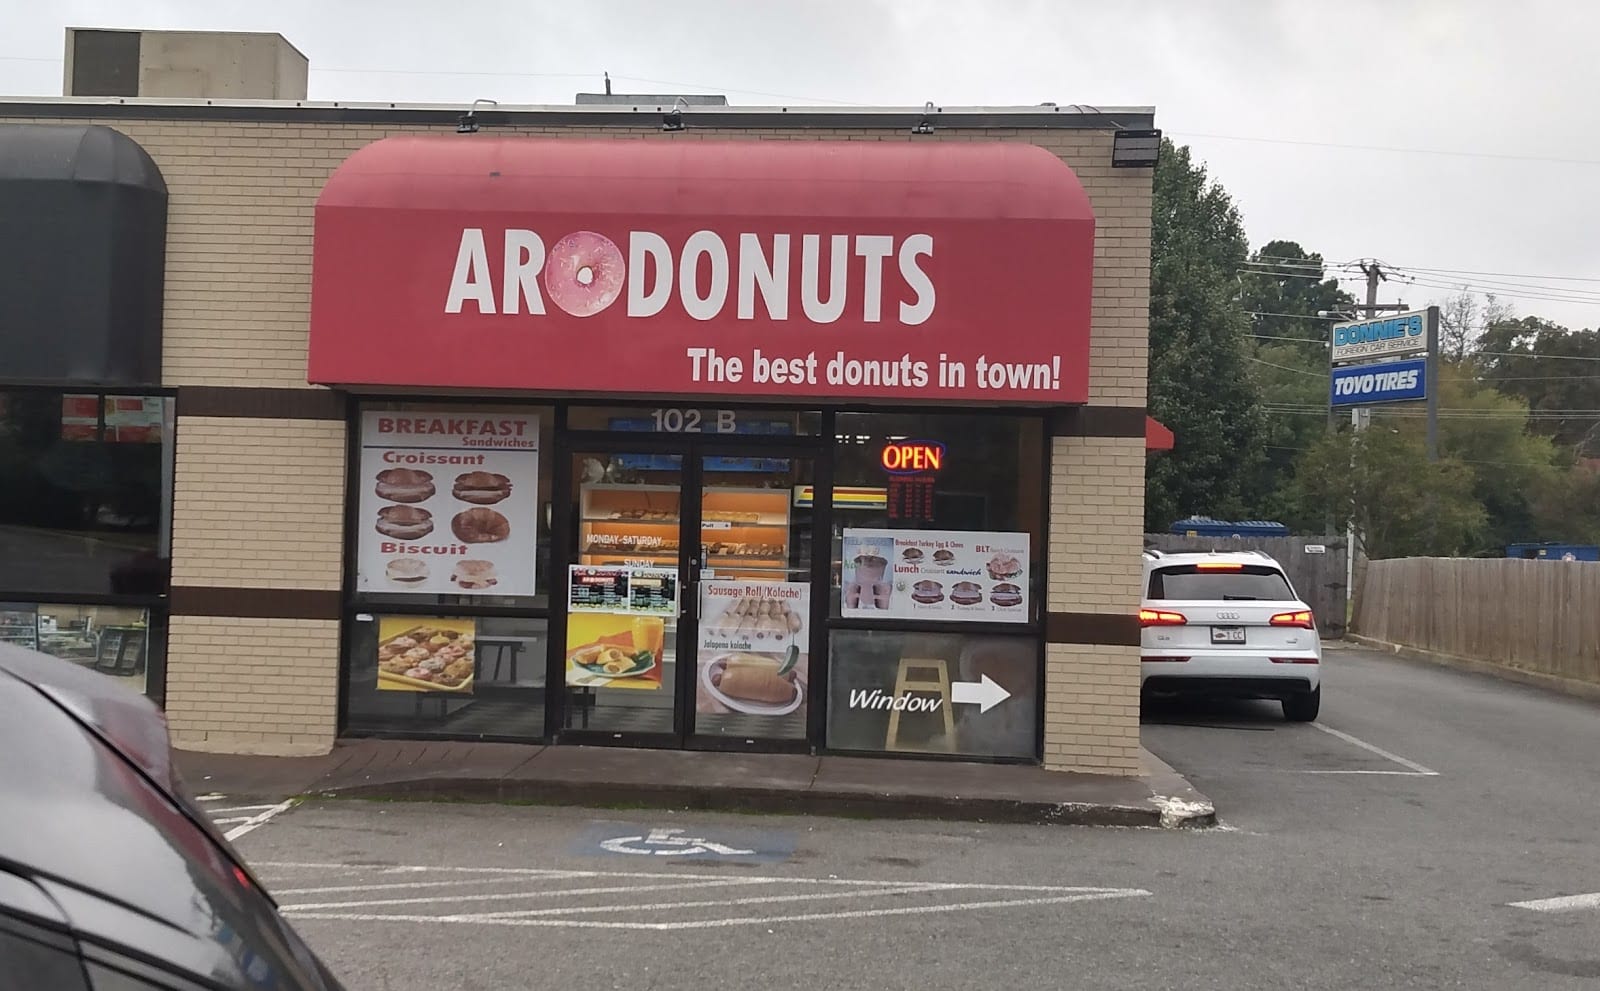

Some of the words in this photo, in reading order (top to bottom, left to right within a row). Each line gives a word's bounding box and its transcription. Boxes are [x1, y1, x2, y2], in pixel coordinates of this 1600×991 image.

[1334, 315, 1423, 347] DONNIE'S
[687, 348, 743, 383] The
[752, 349, 818, 385] best
[826, 351, 929, 387] donuts
[938, 353, 966, 388] in
[975, 354, 1061, 390] town!
[1335, 374, 1375, 395] TOYO
[1375, 369, 1419, 392] TIRES
[378, 418, 527, 436] BREAKFAST
[651, 408, 701, 432] 102
[717, 409, 736, 433] B
[462, 436, 534, 448] Sandwiches
[383, 451, 485, 465] Croissant
[883, 445, 940, 469] OPEN
[381, 542, 469, 555] Biscuit
[976, 545, 990, 553] BLT
[894, 564, 919, 573] Lunch
[708, 584, 743, 598] Sausage
[849, 688, 943, 713] Window
